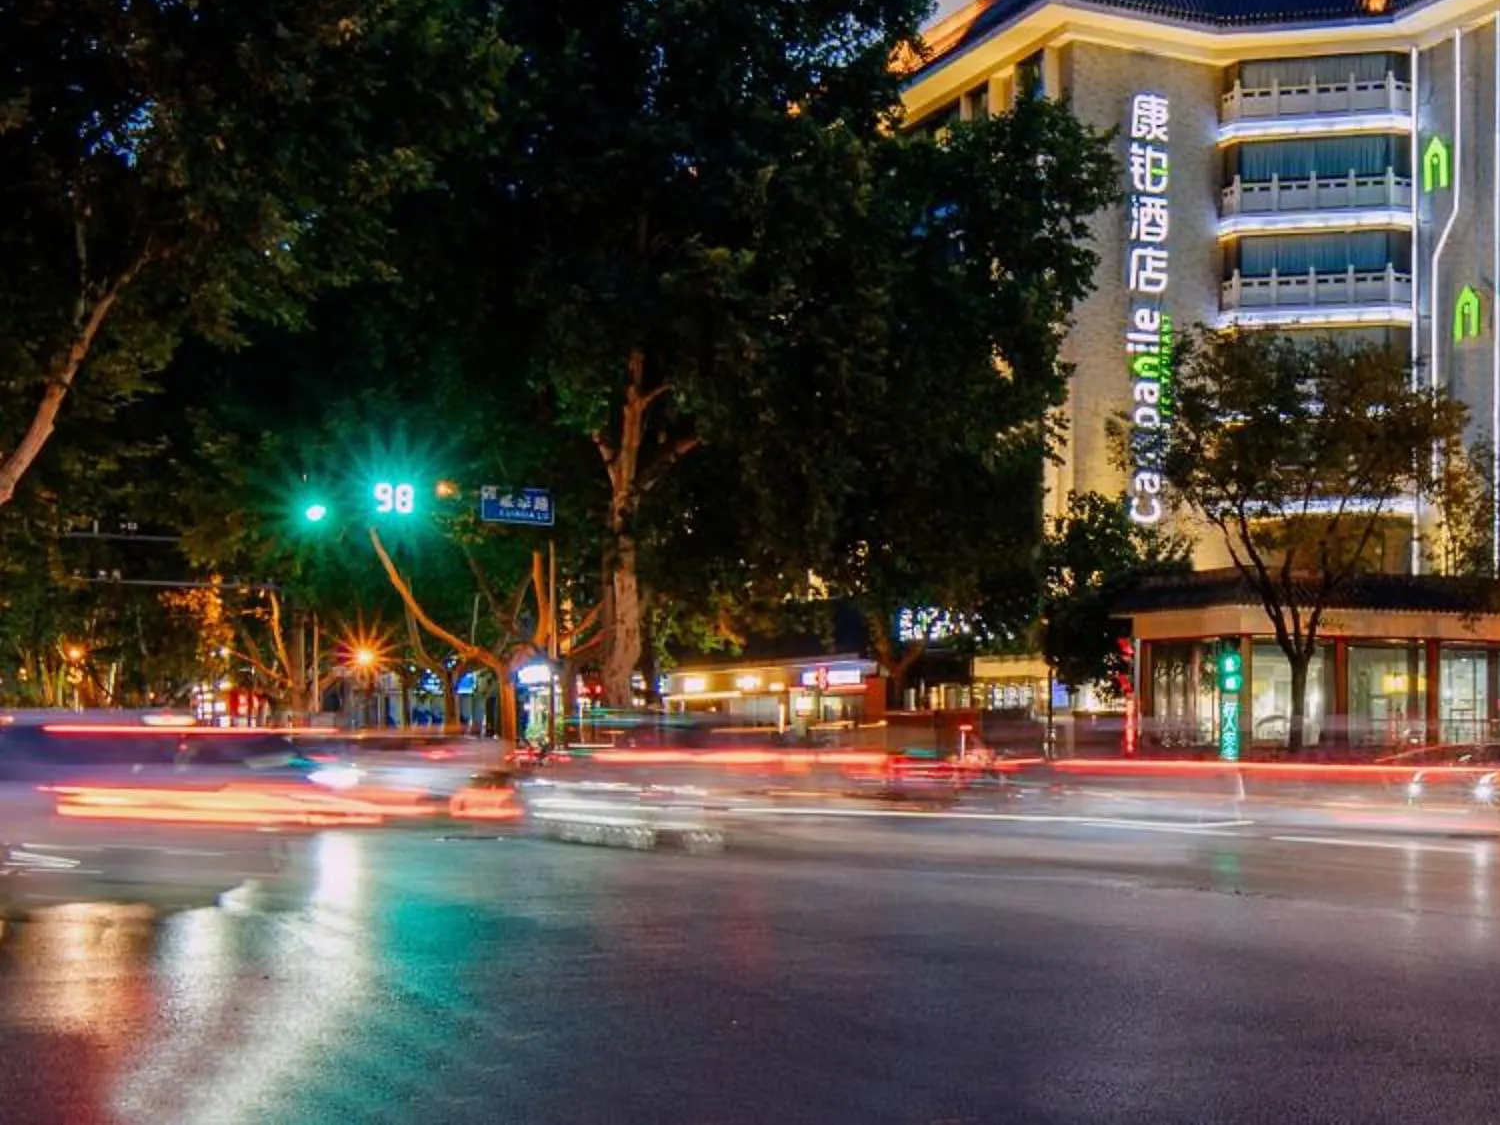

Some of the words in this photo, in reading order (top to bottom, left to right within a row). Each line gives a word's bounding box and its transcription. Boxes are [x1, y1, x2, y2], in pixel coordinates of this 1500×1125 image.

[1130, 94, 1169, 293] 康铂酒店
[374, 482, 414, 514] 98
